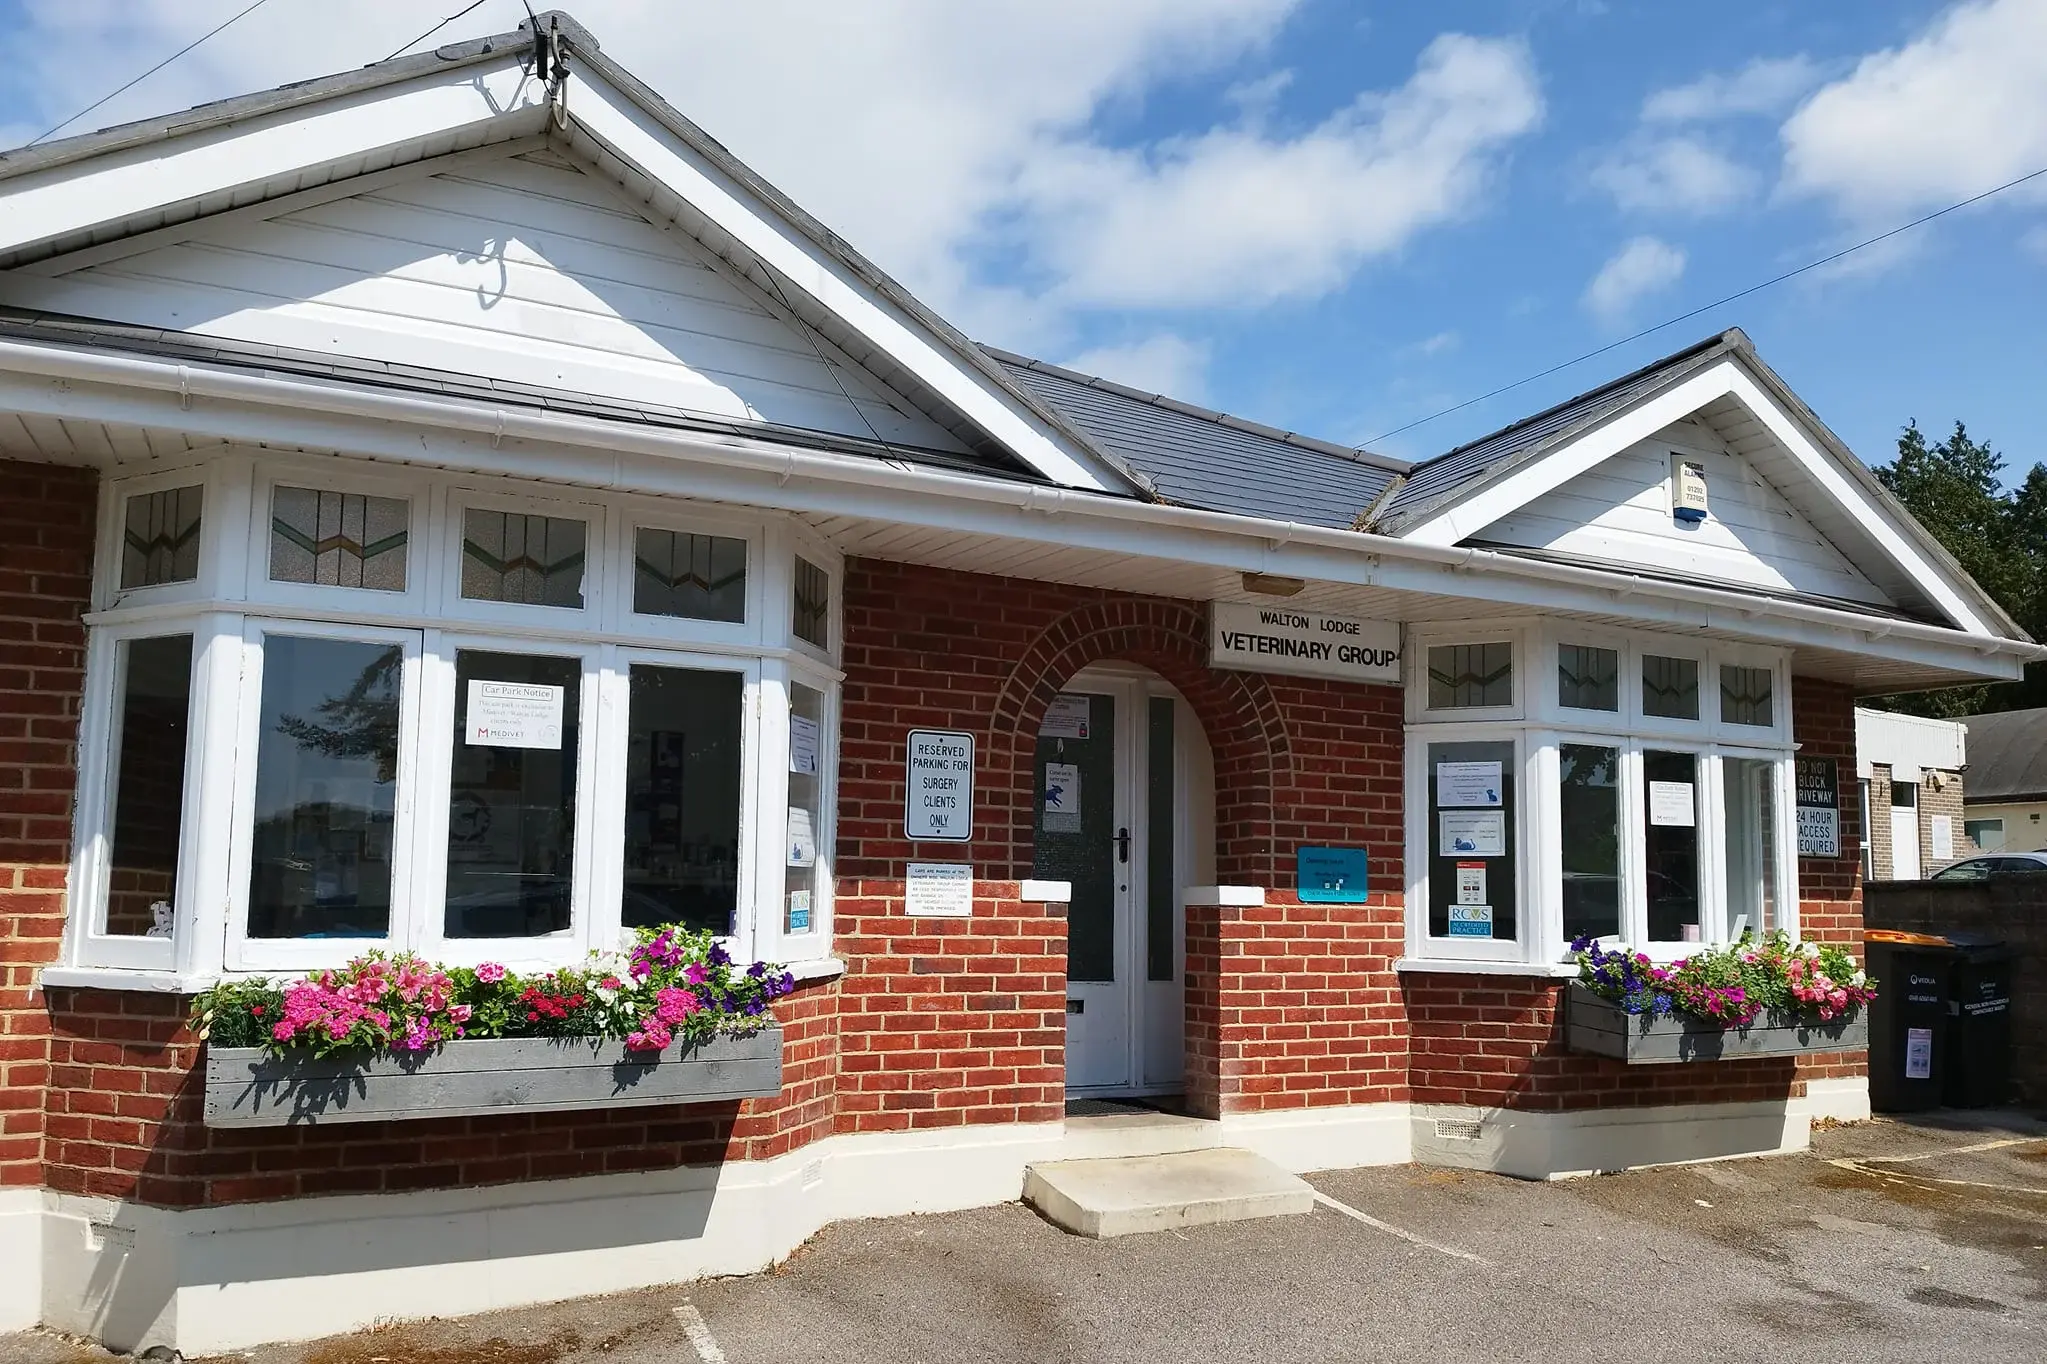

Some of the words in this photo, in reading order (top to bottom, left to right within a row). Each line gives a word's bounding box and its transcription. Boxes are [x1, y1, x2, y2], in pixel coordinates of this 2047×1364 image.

[1260, 611, 1309, 629] WALTON
[1320, 619, 1360, 635] LODGE
[1222, 631, 1332, 660] VETERINARY
[1338, 645, 1396, 667] GROUP
[485, 686, 500, 694] Car
[502, 687, 521, 696] Park
[523, 688, 550, 697] Notice
[919, 744, 965, 757] RESERVED
[912, 757, 949, 770] PARKING
[952, 760, 969, 771] FOR
[1811, 761, 1826, 774] NOT
[923, 777, 958, 790] SURGERY
[1799, 775, 1826, 788] BLOCK
[923, 796, 956, 809] CLIENTS
[1797, 789, 1833, 803] RIVEWAY
[929, 814, 949, 826] ONLY
[1796, 810, 1805, 822] 24
[1810, 811, 1832, 824] HOUR
[1799, 825, 1830, 838] ACCESS
[1798, 840, 1834, 852] EQUIRED
[1452, 908, 1488, 920] RCVS
[1918, 977, 1936, 985] VEOLIA
